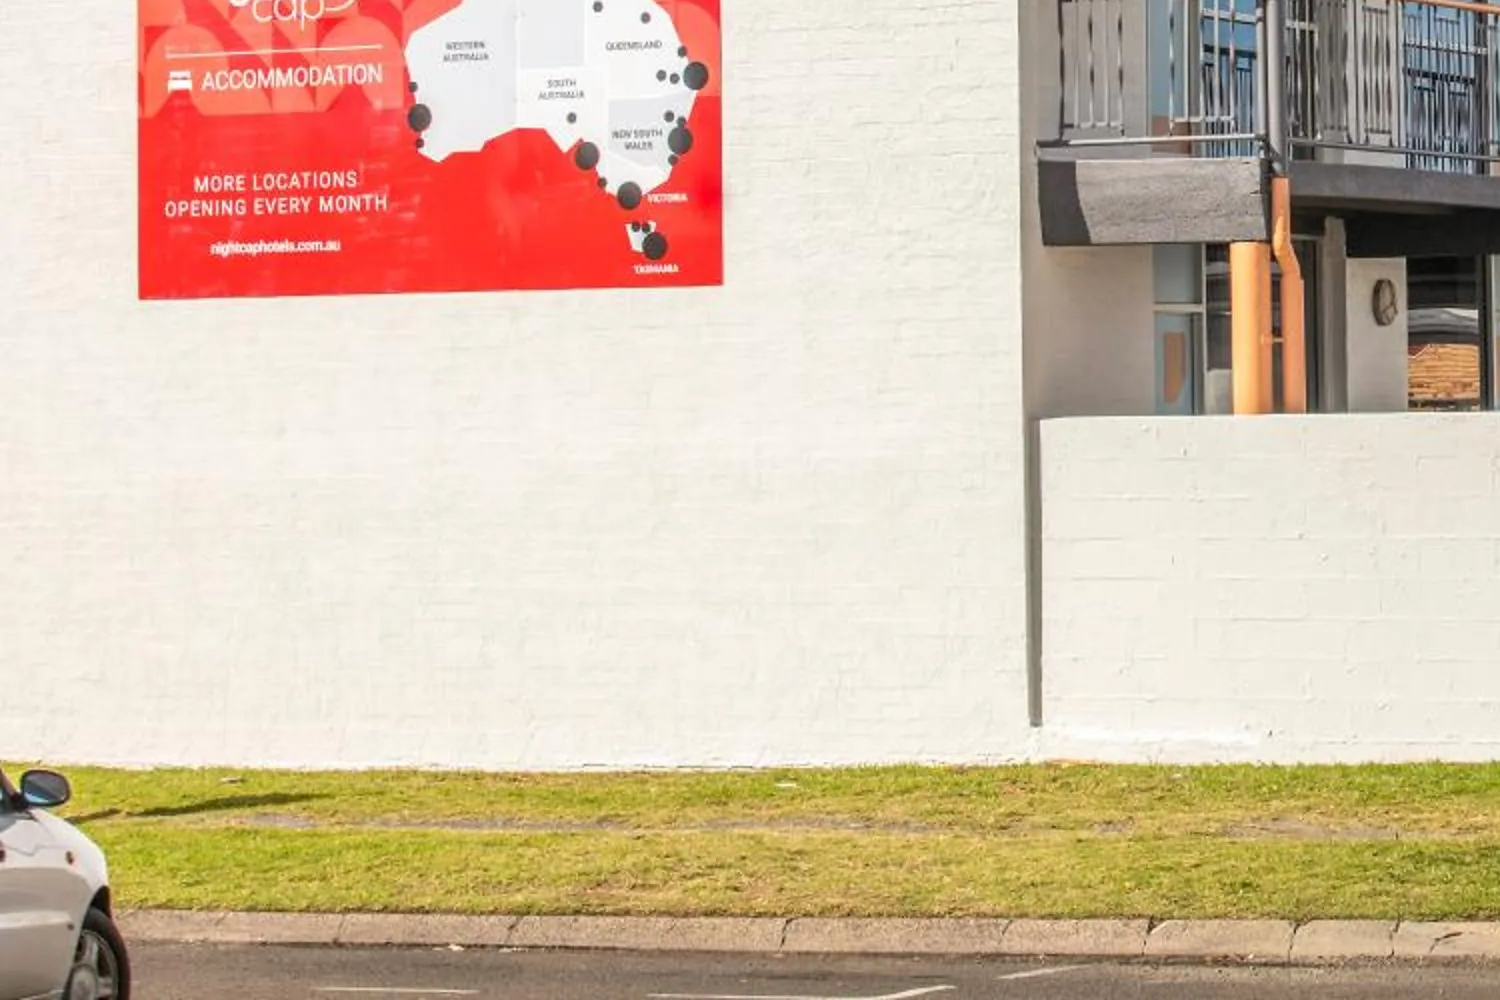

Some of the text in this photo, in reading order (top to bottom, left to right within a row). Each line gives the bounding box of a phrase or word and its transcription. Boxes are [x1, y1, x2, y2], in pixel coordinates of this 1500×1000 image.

[605, 39, 663, 52] QUEENSLAND
[202, 63, 384, 92] ACCOMMODATION
[633, 128, 663, 139] SOUTH
[193, 170, 358, 194] MORE LOCATIONS
[164, 193, 387, 219] OPENING EVERY MONTH
[211, 239, 341, 258] nightcaphotels.com.au
